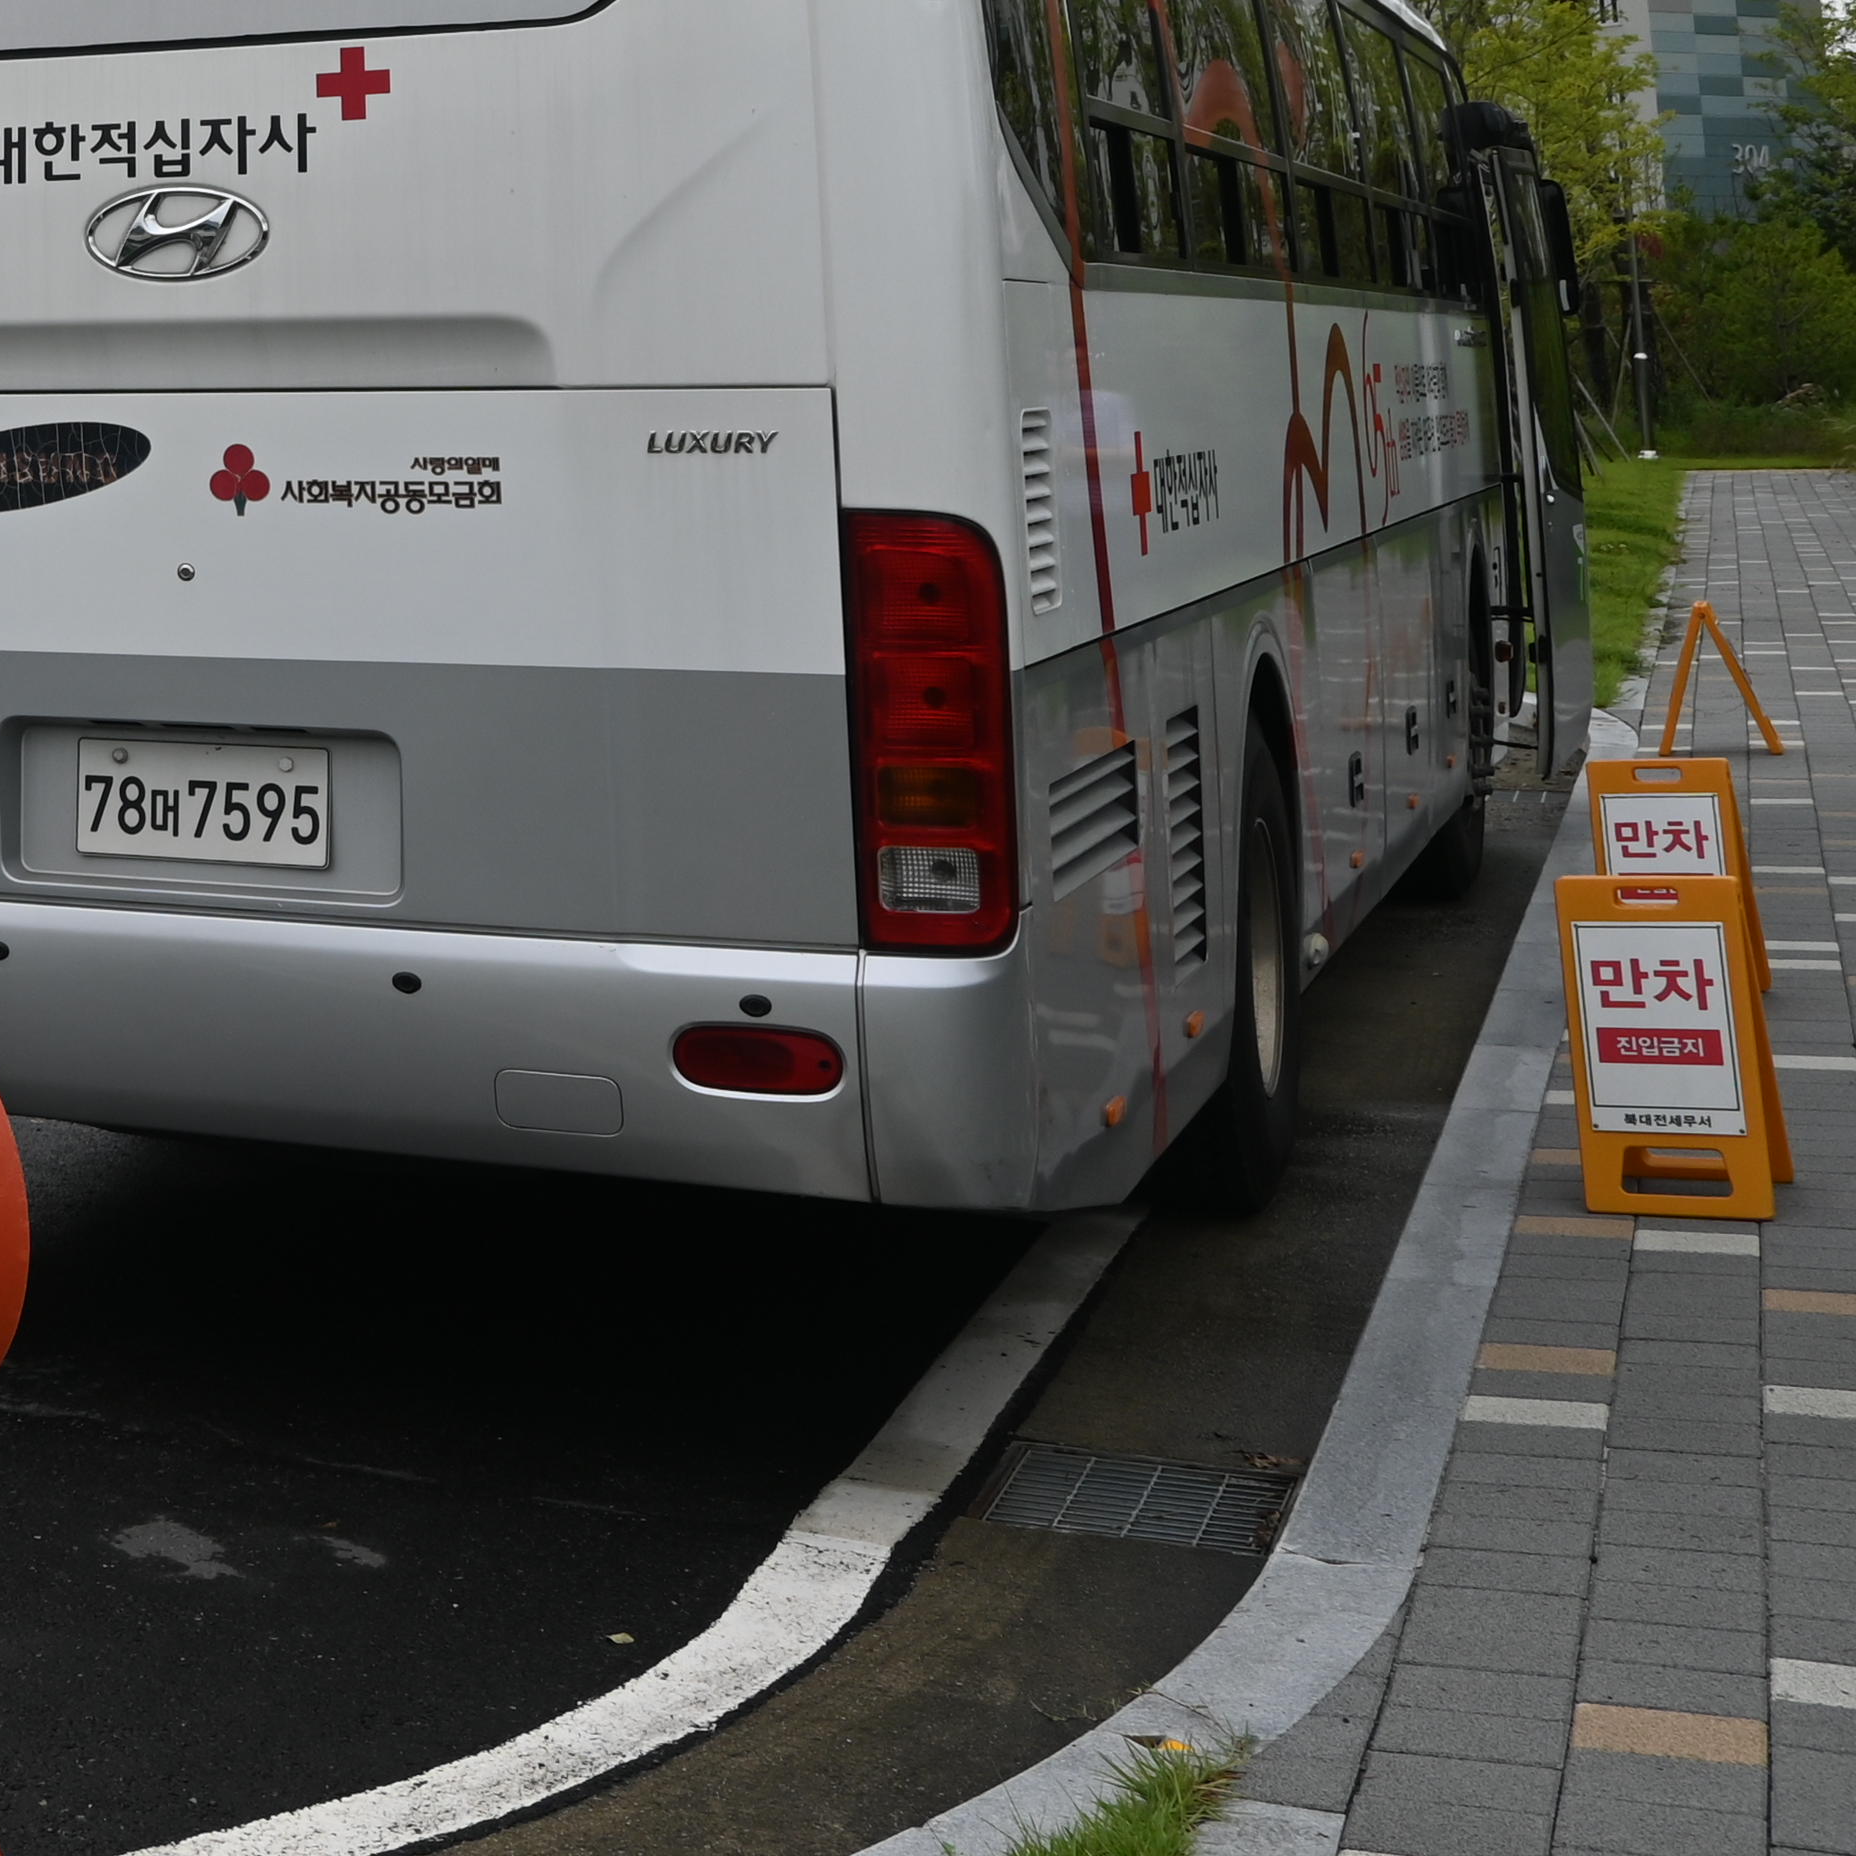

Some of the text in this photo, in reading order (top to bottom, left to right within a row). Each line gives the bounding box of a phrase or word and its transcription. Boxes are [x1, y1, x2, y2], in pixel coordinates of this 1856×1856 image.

[1731, 143, 1775, 175] 304
[646, 429, 778, 455] LUXURY
[410, 457, 500, 476] 사랑의열매
[281, 479, 502, 515] 사회복지공동모금회
[1153, 448, 1219, 534] 대한적십자사
[84, 775, 320, 845] 78머7595
[1614, 820, 1709, 859] 만차
[1590, 958, 1714, 1011] 만차
[1616, 1036, 1705, 1057] 진입금지
[1623, 1113, 1713, 1128] 북대전세무서
